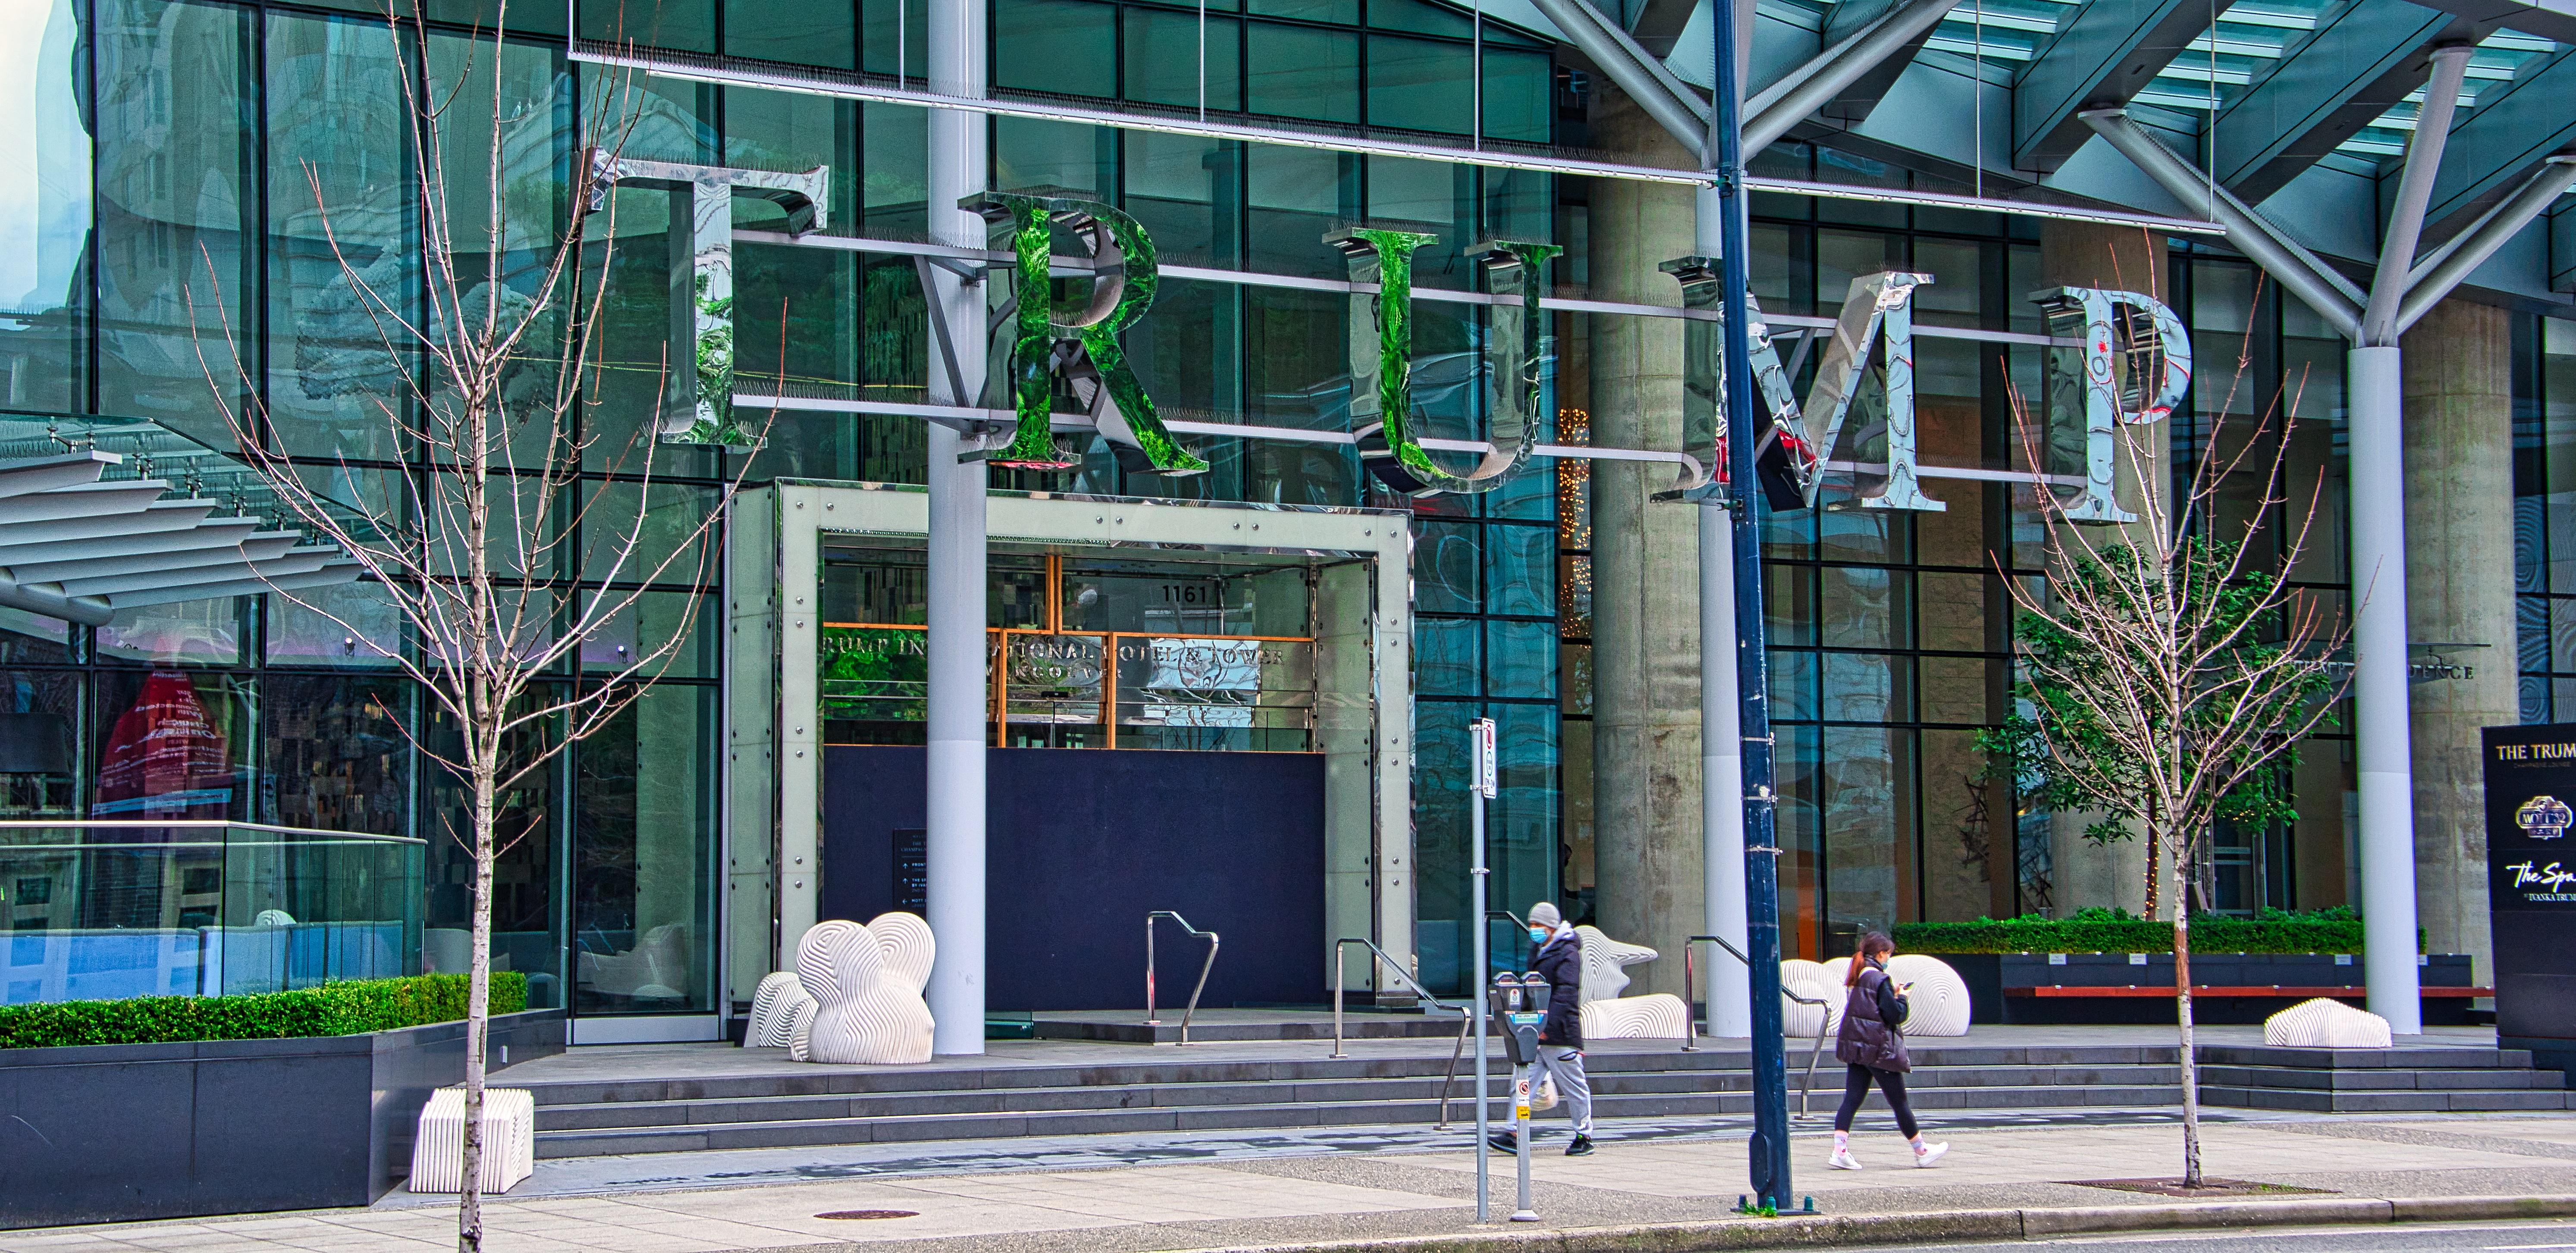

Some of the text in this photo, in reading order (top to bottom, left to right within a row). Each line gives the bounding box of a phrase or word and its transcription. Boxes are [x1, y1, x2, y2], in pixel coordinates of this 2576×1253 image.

[582, 146, 2191, 524] TRUMP
[1163, 585, 1205, 603] 1161
[823, 637, 889, 654] RUMP
[1185, 646, 1203, 663] &
[1208, 648, 1284, 665] TOWER
[2408, 665, 2475, 680] DENCE
[2495, 742, 2576, 760] THE TRUM
[2505, 860, 2576, 893] The Spa
